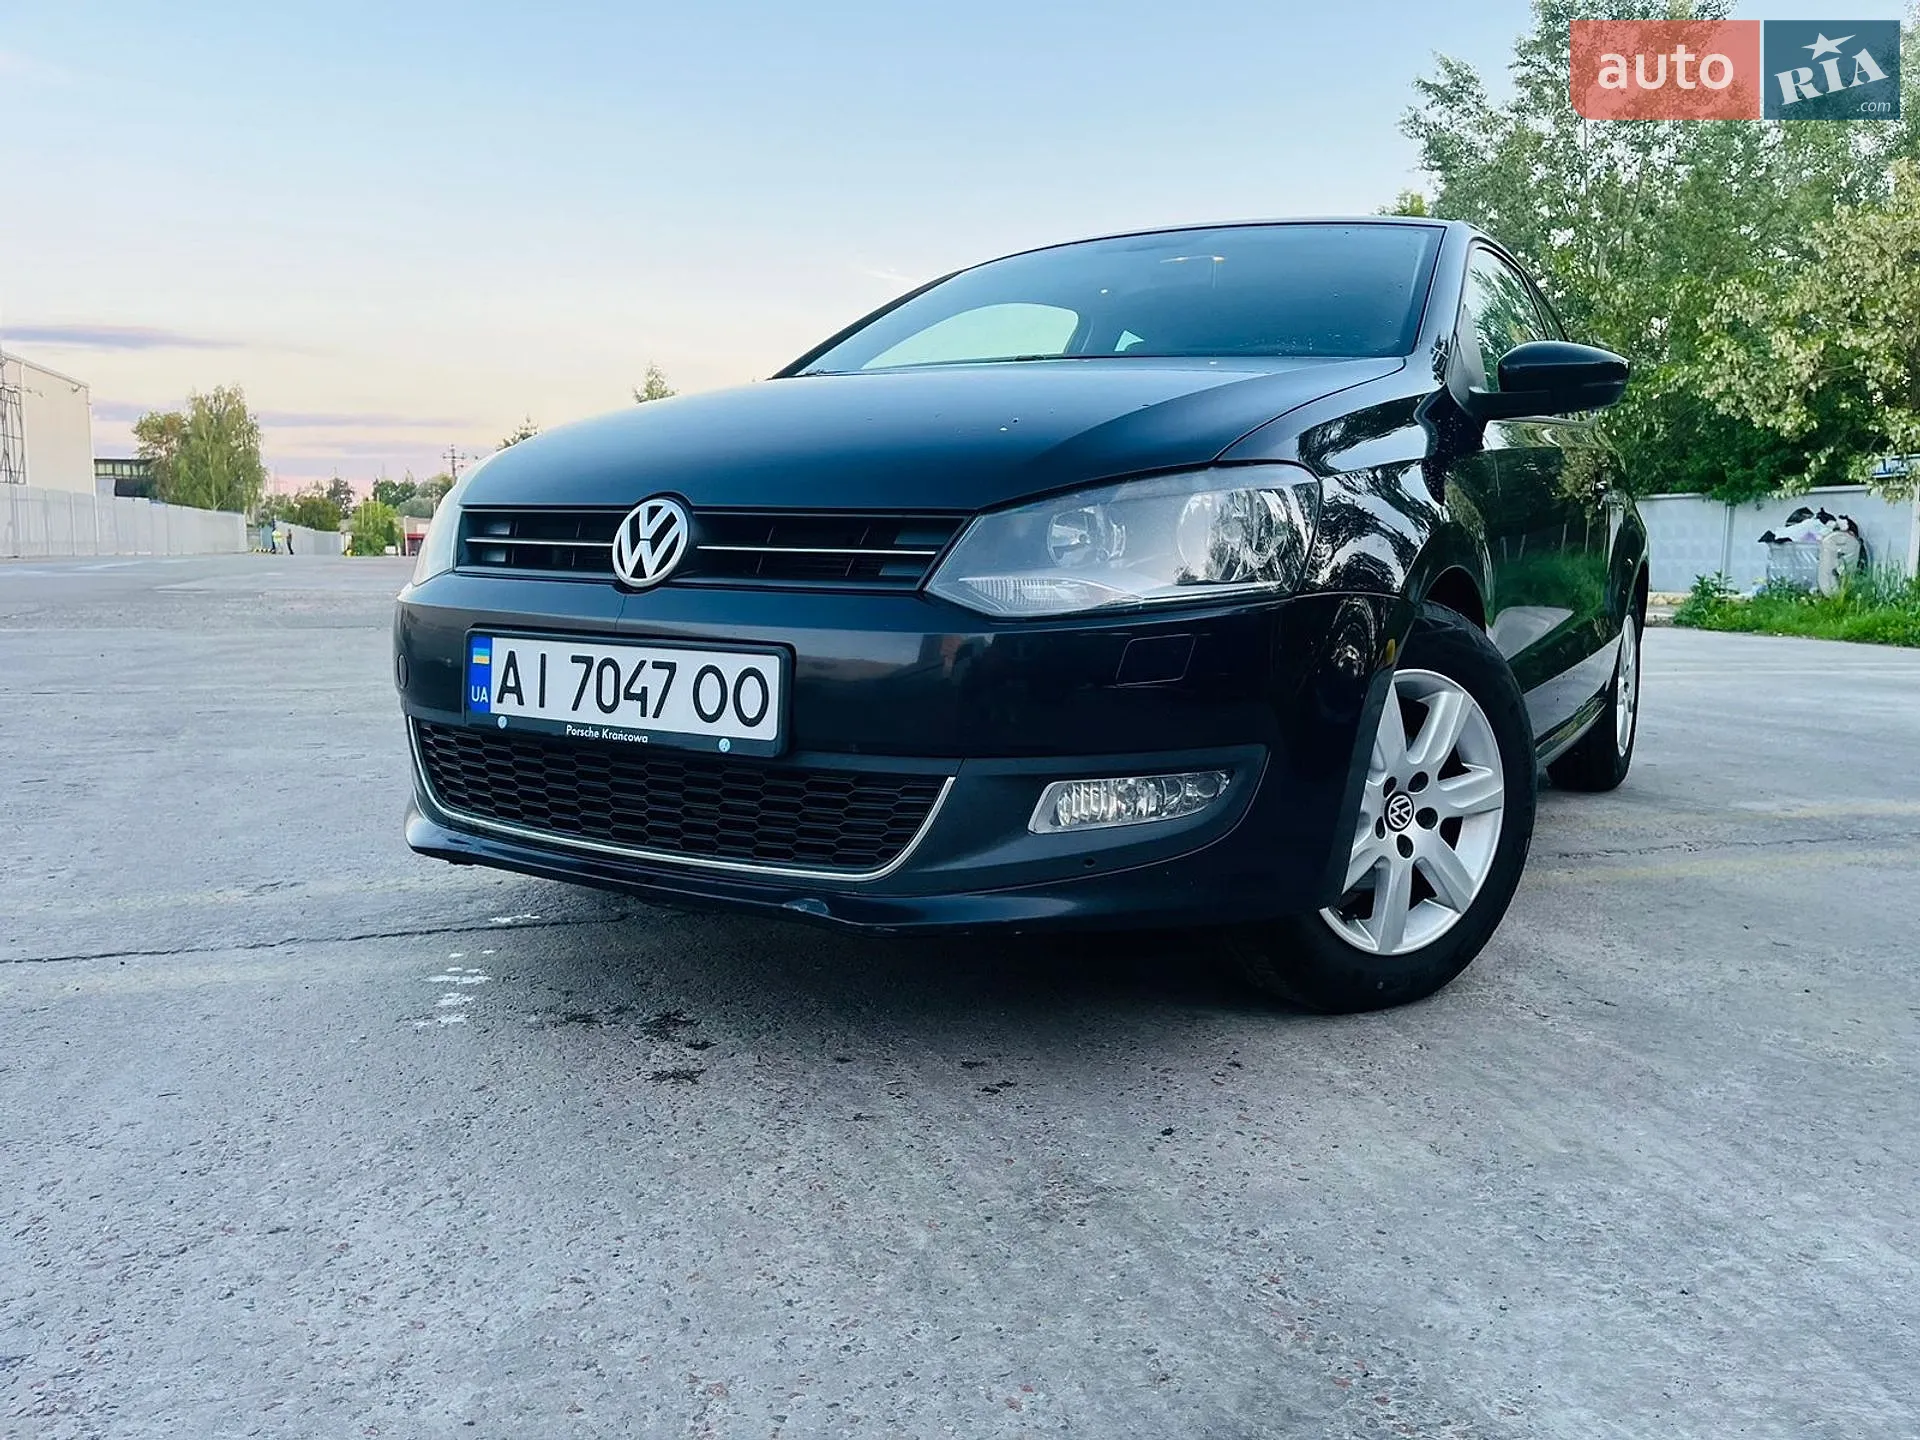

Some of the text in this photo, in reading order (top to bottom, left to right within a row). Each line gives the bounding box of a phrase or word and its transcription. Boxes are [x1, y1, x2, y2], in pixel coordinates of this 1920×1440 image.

[471, 685, 489, 703] UA
[496, 650, 770, 728] AI 7047 OO
[566, 724, 600, 739] Porsche
